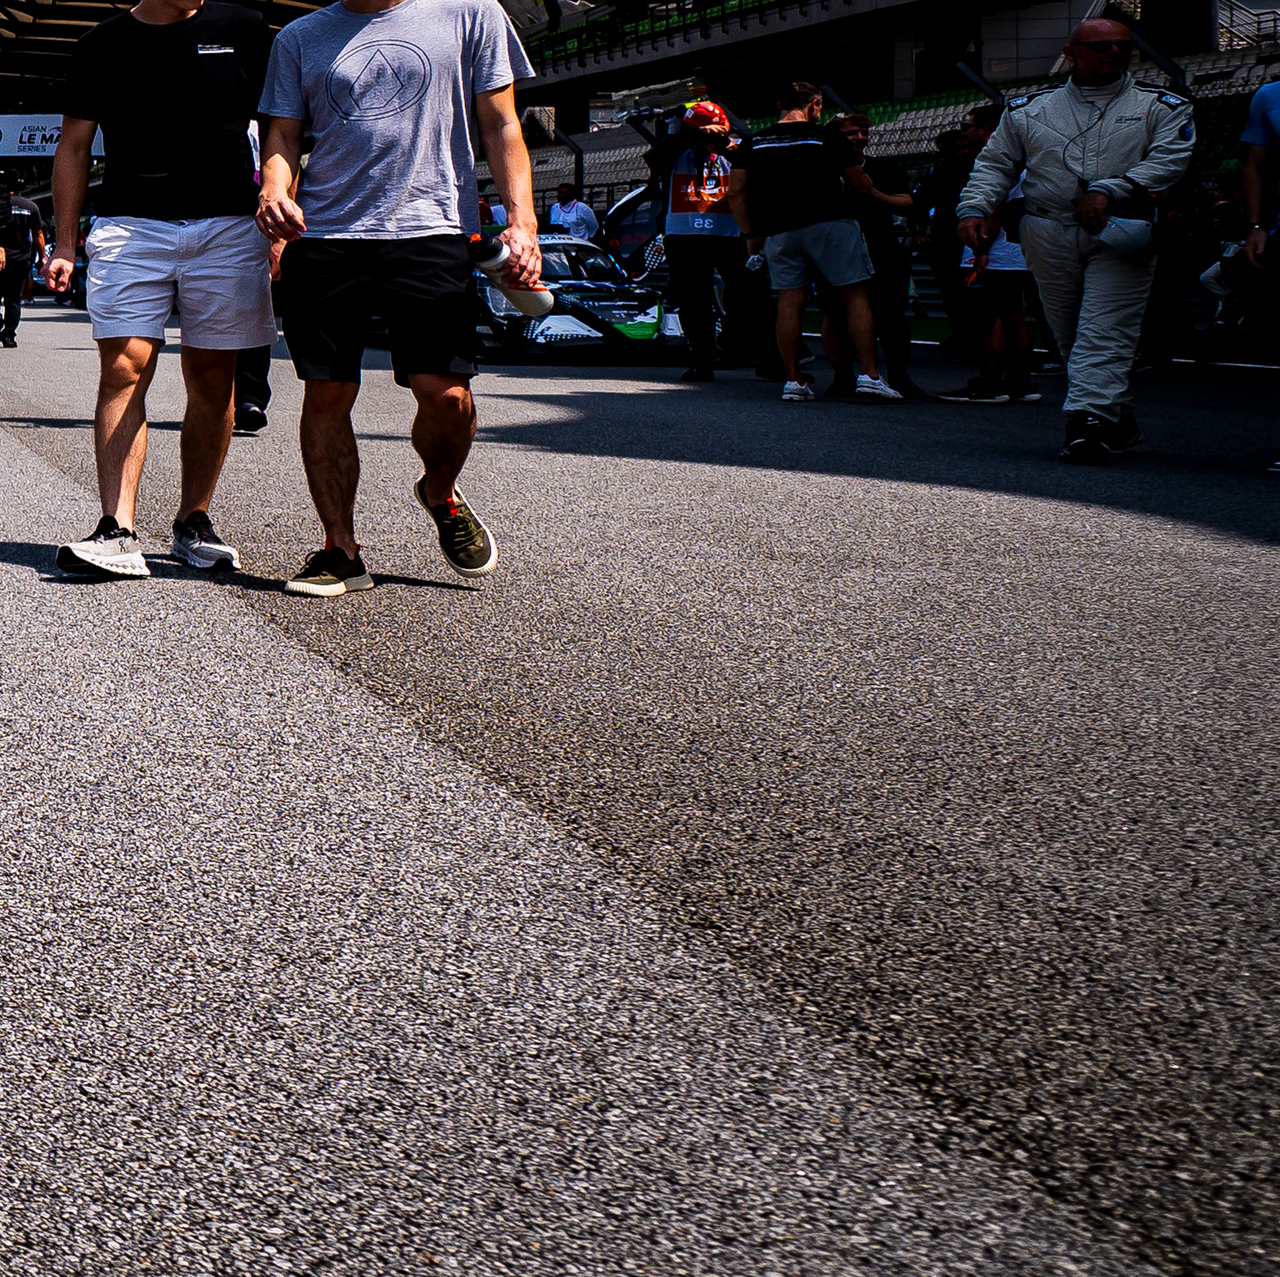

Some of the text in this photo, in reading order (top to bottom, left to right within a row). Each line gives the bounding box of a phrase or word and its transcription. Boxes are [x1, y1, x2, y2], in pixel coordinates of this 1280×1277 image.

[18, 133, 62, 145] LE MA
[17, 145, 47, 153] SERIES
